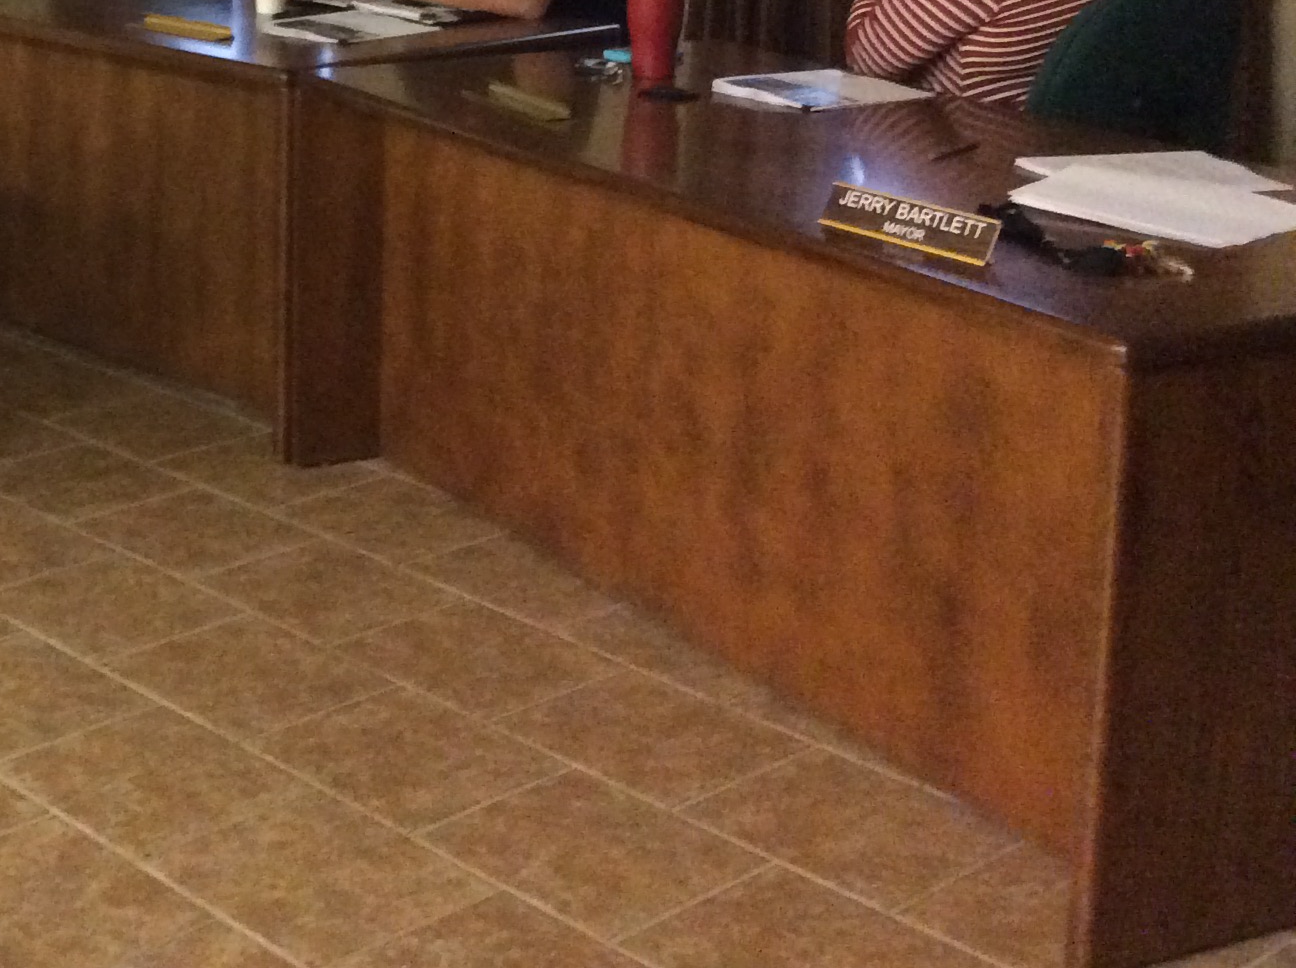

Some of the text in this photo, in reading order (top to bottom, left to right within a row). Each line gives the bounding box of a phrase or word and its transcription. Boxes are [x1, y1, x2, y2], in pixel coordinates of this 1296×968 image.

[838, 189, 988, 239] JERRY BARTLETT
[882, 221, 926, 242] MAYOR
